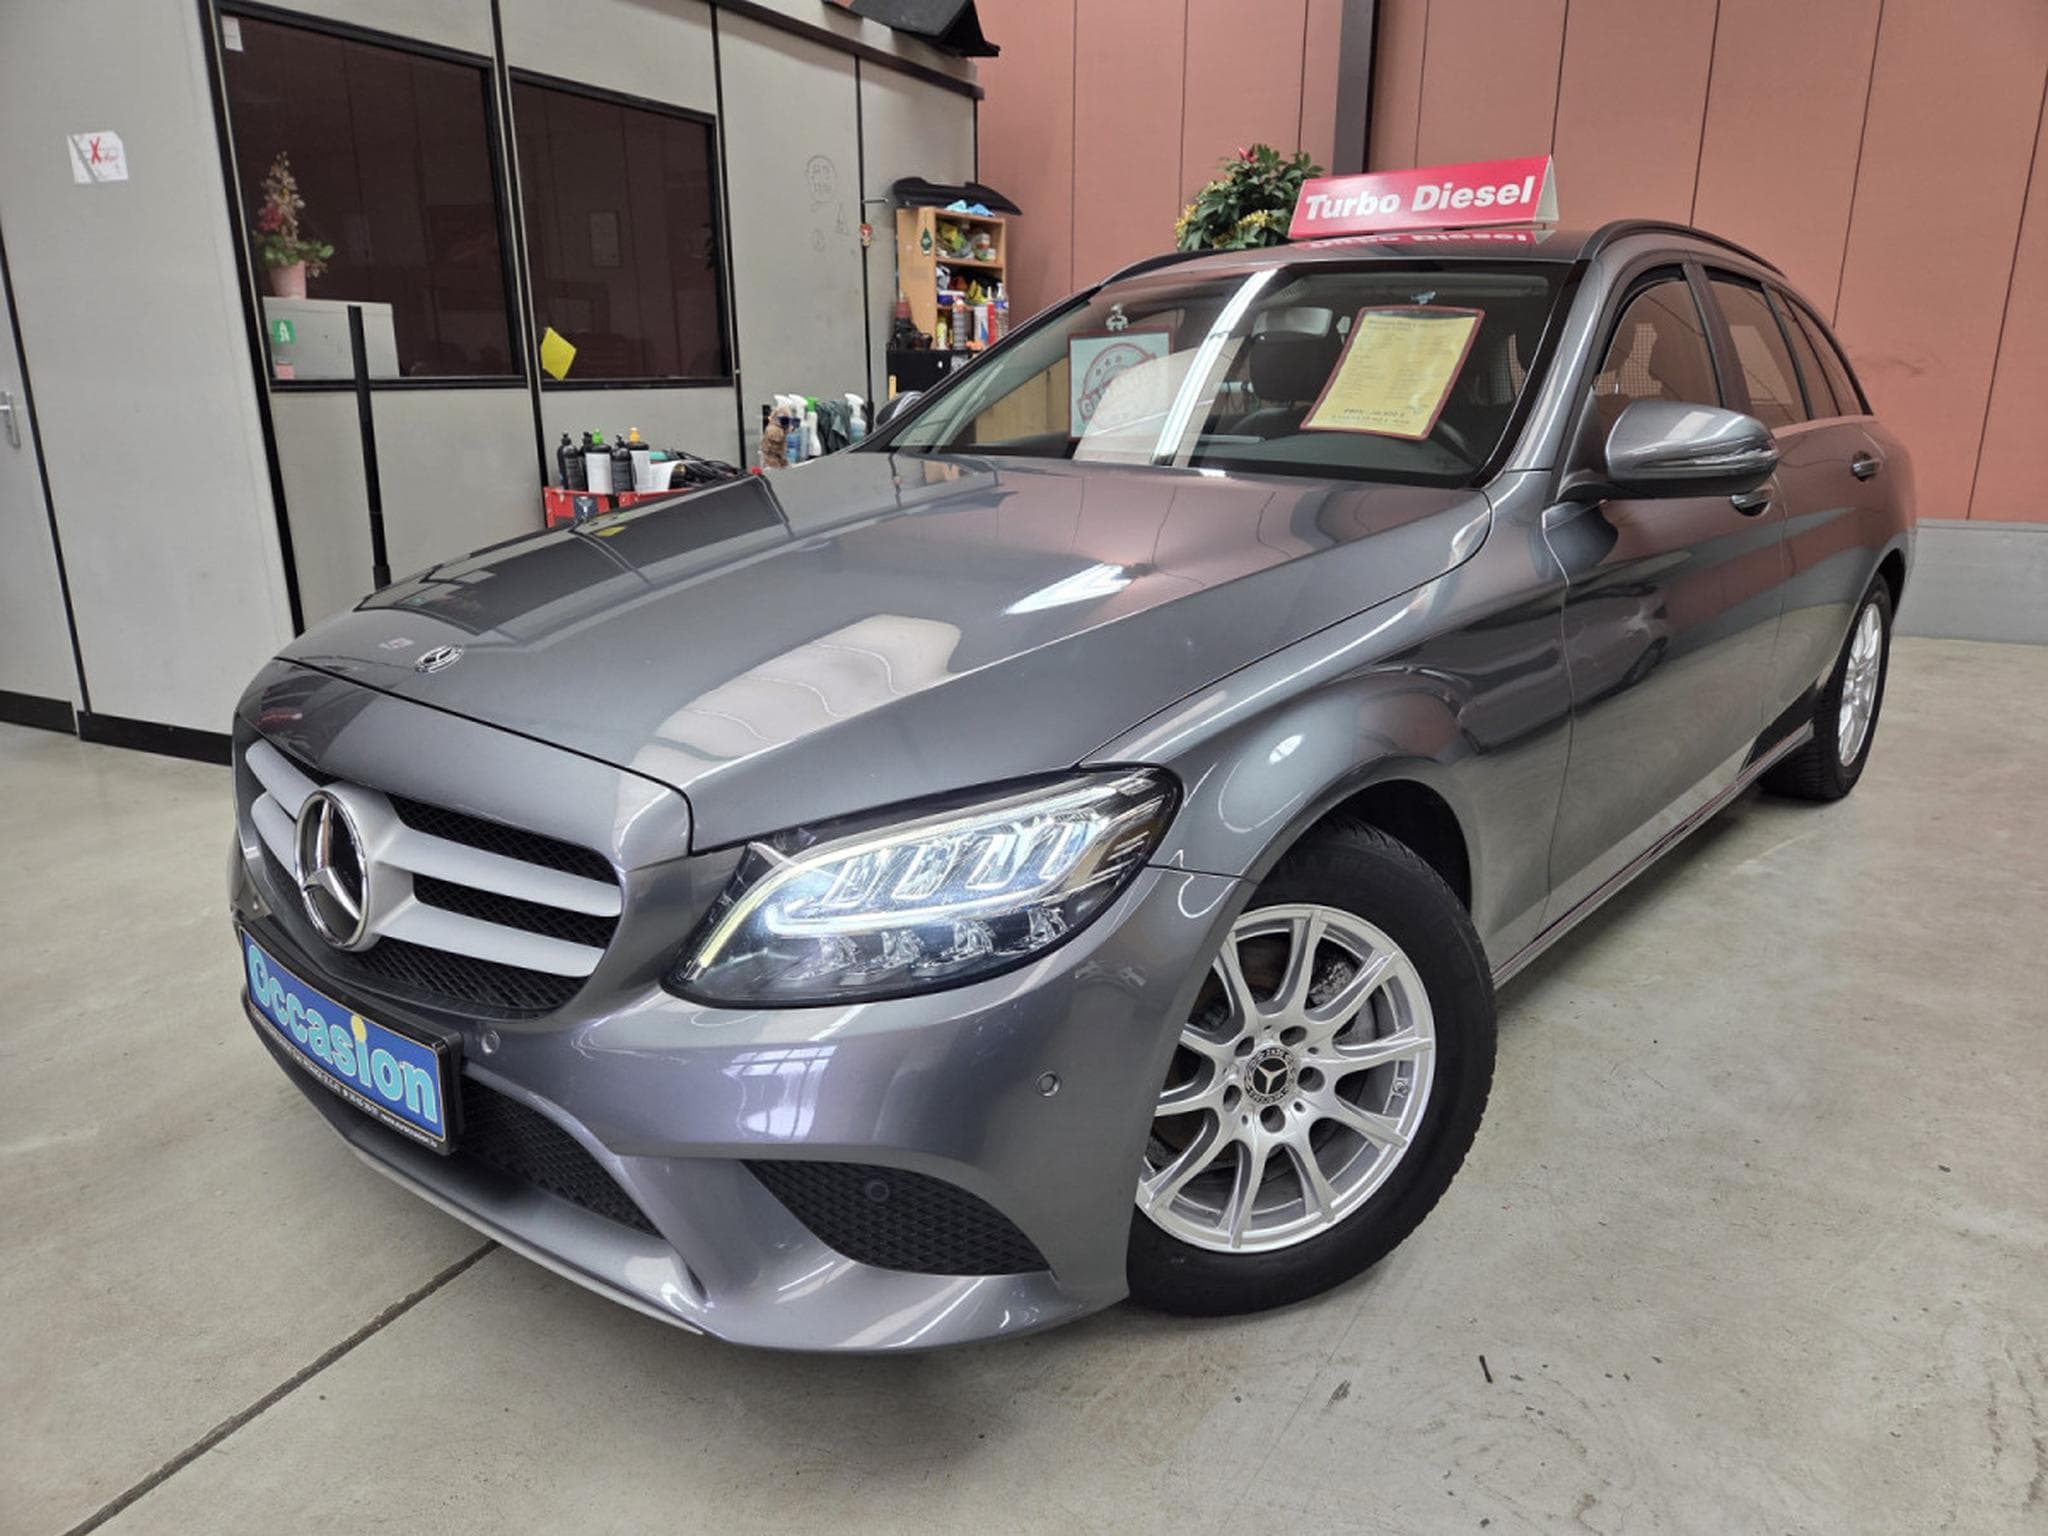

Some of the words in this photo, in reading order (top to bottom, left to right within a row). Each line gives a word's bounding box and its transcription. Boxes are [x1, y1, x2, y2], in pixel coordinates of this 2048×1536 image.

[1306, 190, 1401, 220] Turbo
[1412, 176, 1535, 212] Diesel
[249, 944, 438, 1123] Occasion
